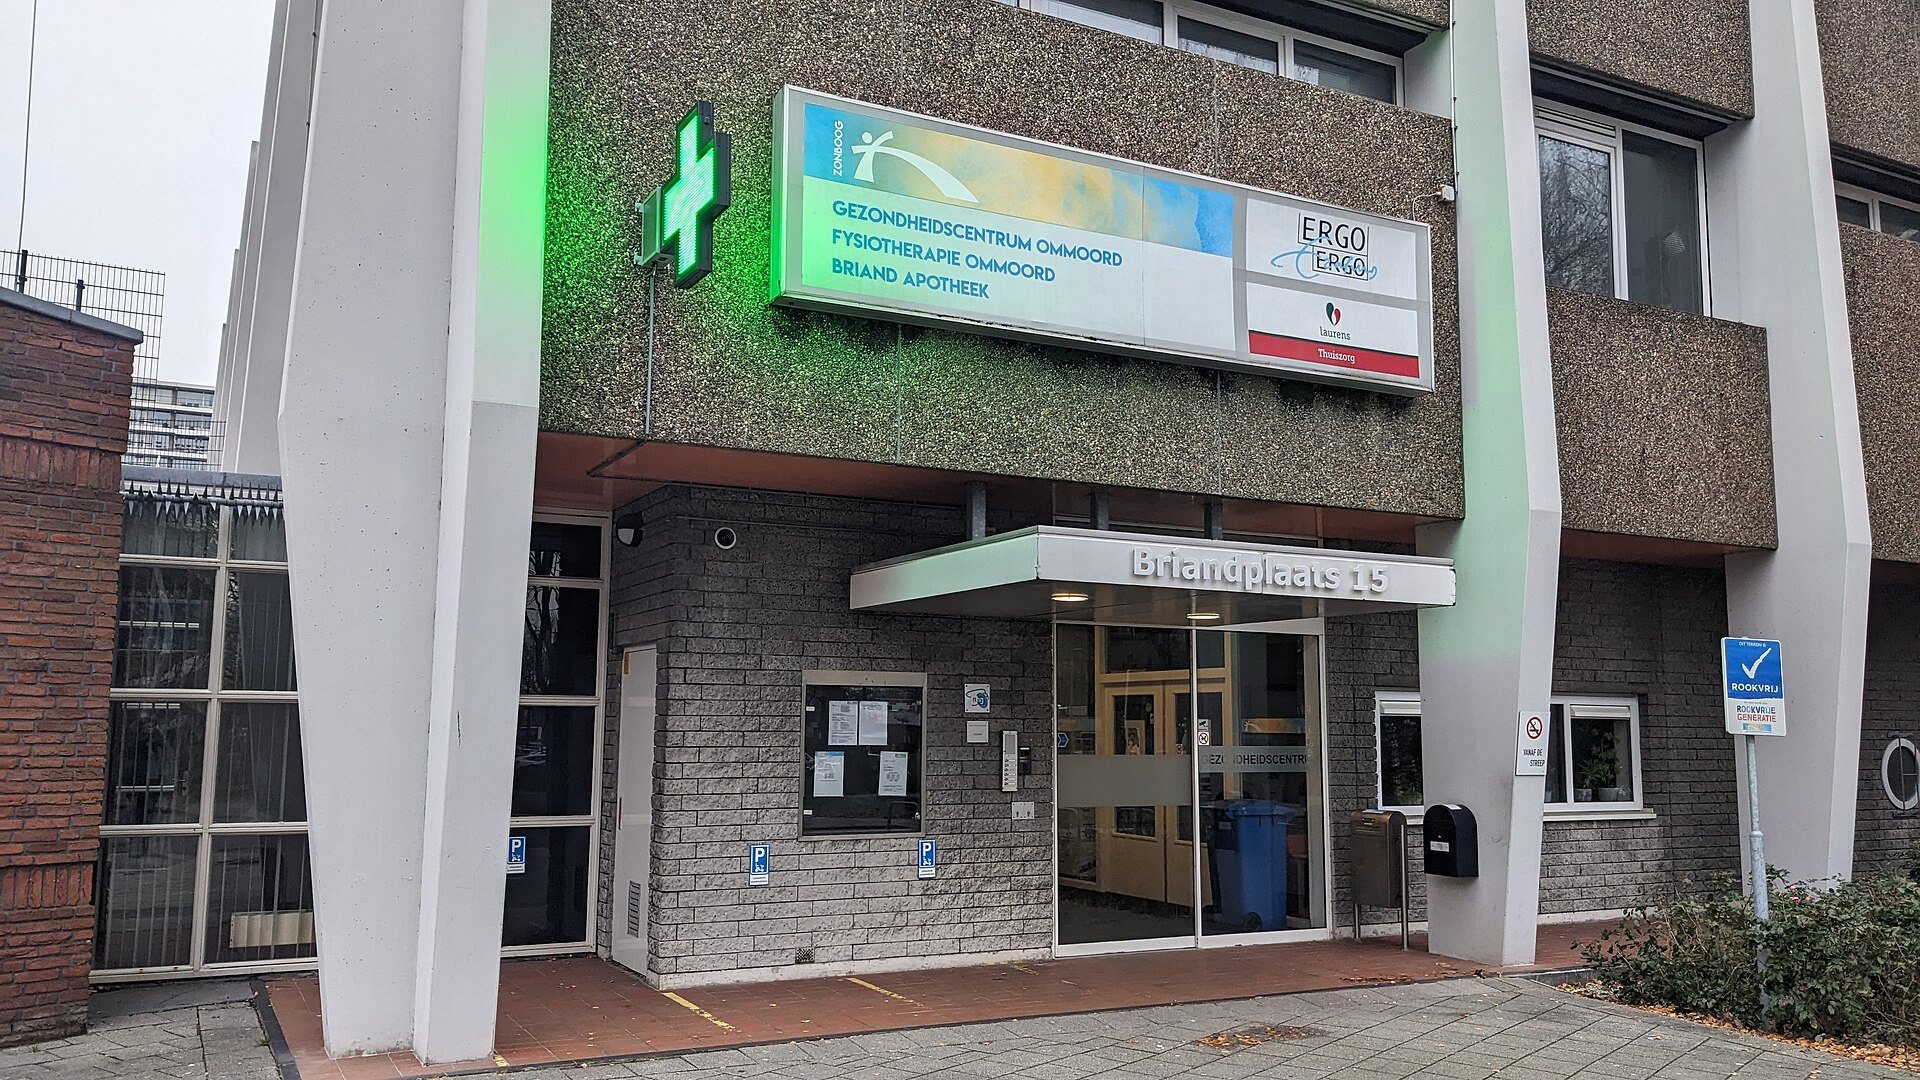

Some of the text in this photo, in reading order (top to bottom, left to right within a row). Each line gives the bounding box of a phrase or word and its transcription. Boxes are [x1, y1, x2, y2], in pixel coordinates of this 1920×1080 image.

[833, 120, 844, 177] ZONBOOG
[832, 200, 1123, 267] GEZONDHEIDSCENTRUM OMMOORD
[1302, 216, 1366, 251] ERGO
[832, 229, 1056, 282] FYSIOTHERAPIE OMMOORD
[1316, 251, 1366, 277] ERGO
[832, 258, 990, 299] BRIAND APOTHEEK
[1319, 326, 1351, 341] laurens
[1318, 348, 1356, 365] Thuiszorg
[1132, 547, 1389, 593] Briandplaats 15
[1731, 683, 1779, 692] ROOKVRIJ
[1736, 705, 1776, 714] ROOKVRIJE
[1737, 714, 1776, 722] GENERATIE
